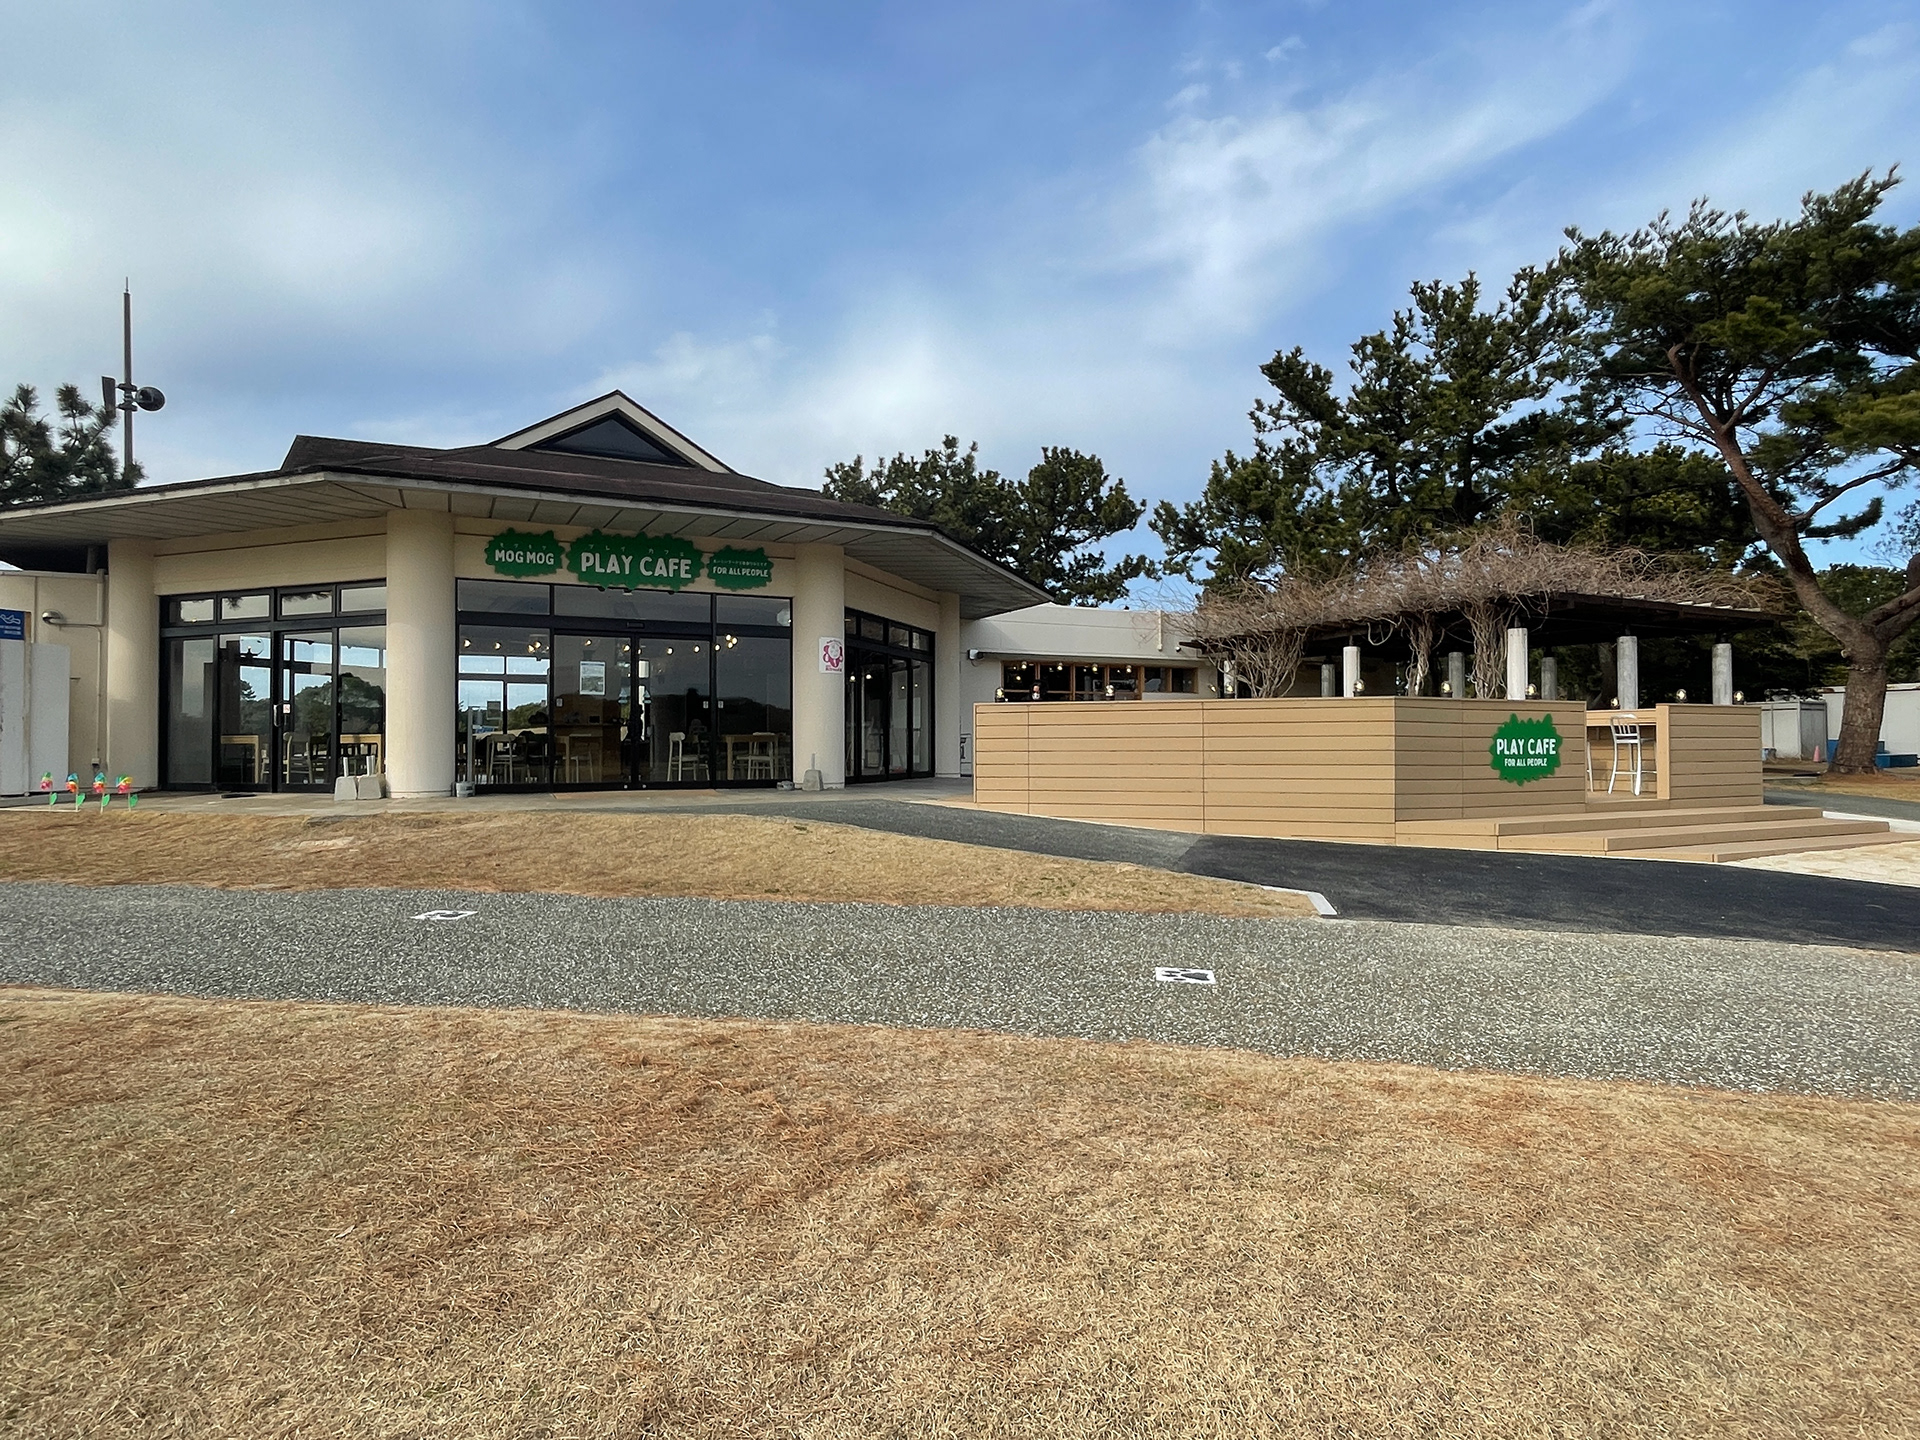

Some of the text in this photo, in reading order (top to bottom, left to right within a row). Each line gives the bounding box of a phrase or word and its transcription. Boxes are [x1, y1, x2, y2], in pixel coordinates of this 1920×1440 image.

[495, 549, 555, 565] MOG MOG
[581, 552, 692, 579] PLAY CAFE
[712, 566, 769, 578] FOR ALL PEOPLE
[1496, 738, 1556, 755] PLAY CAFE
[1504, 758, 1548, 767] FOR ALL PEOPLE
